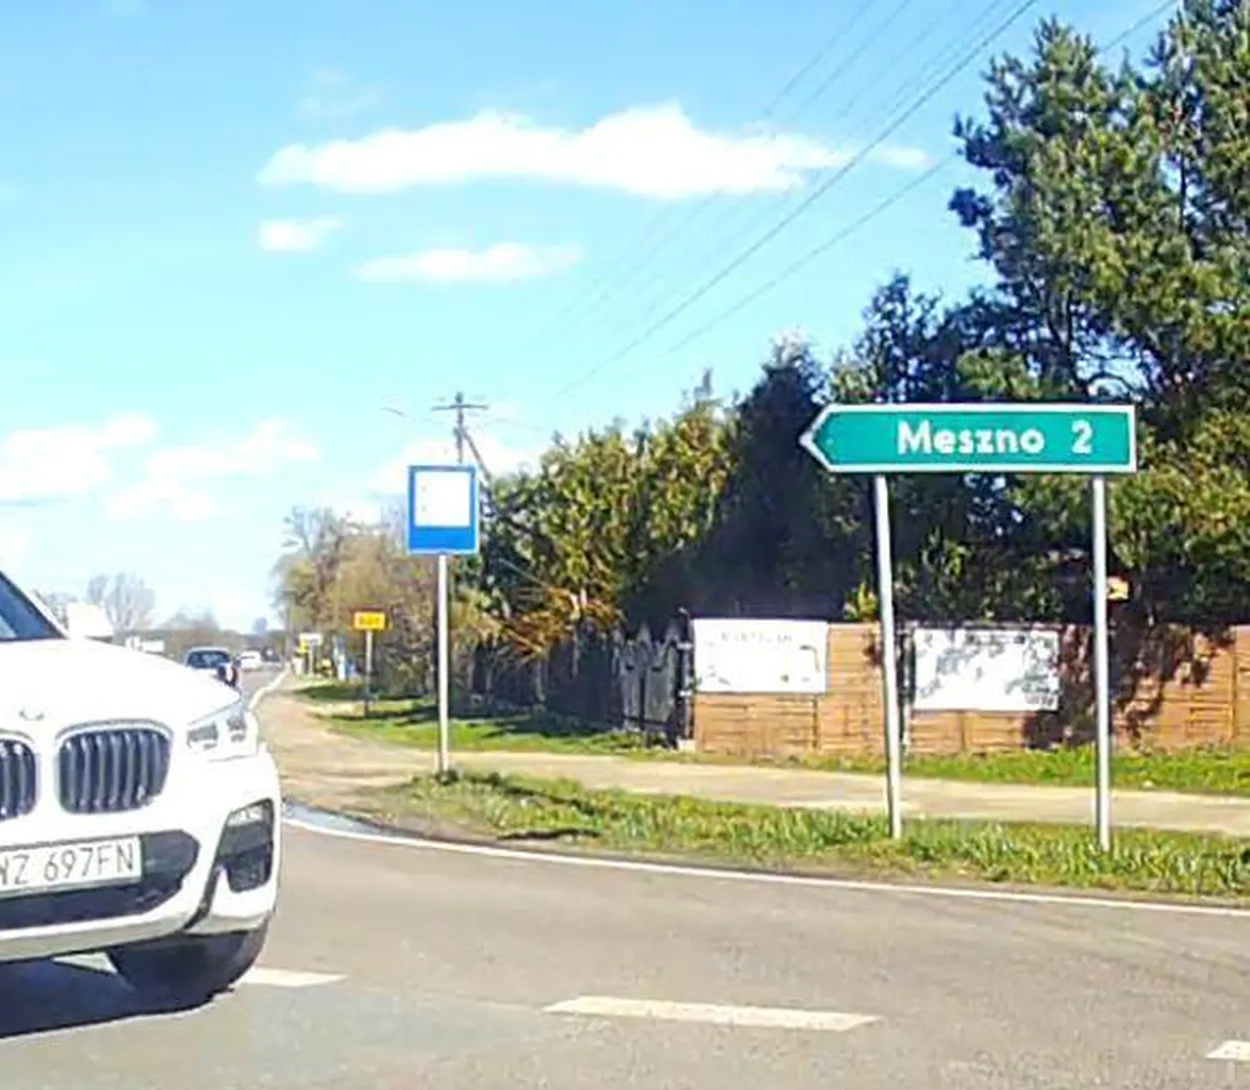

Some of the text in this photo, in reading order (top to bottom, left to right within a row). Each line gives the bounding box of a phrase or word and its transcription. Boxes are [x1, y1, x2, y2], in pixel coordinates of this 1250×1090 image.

[897, 420, 1093, 454] Meszno 2
[43, 843, 134, 882] 697FN
